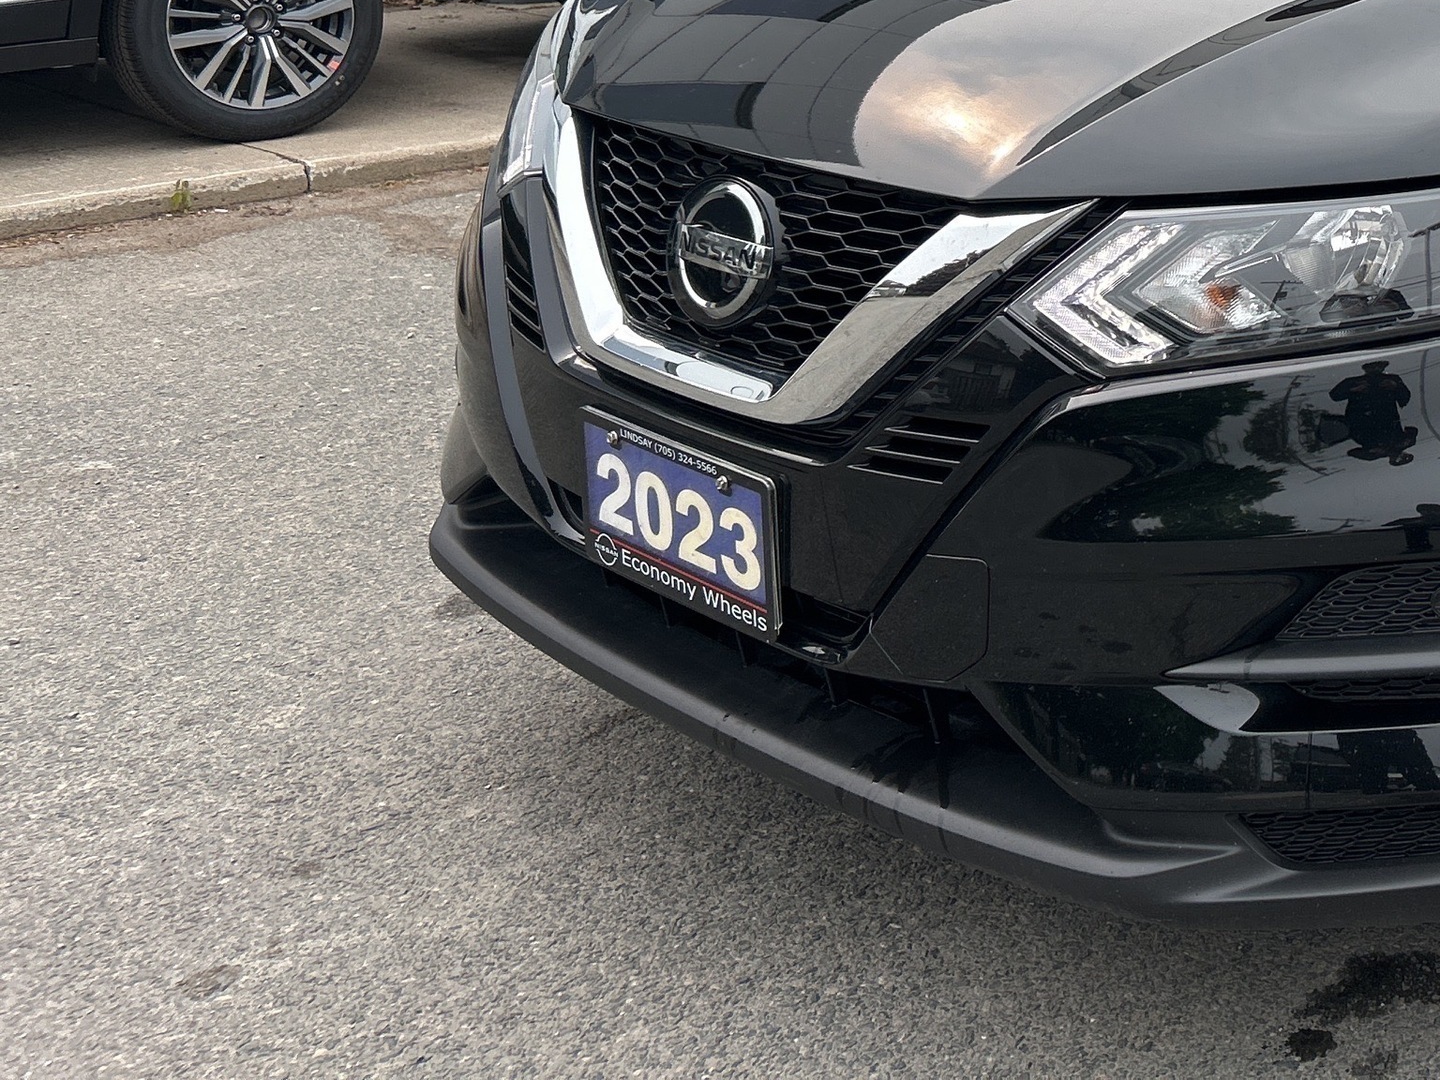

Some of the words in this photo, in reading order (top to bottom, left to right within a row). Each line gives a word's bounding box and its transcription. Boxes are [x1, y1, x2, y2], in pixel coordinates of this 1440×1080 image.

[681, 228, 758, 271] NISSAN
[619, 428, 653, 448] LINDSAY
[654, 442, 676, 461] (705)
[678, 452, 718, 476] 324-5566
[597, 453, 761, 591] 2023
[621, 548, 697, 601] Economy
[702, 586, 767, 632] Wheels
